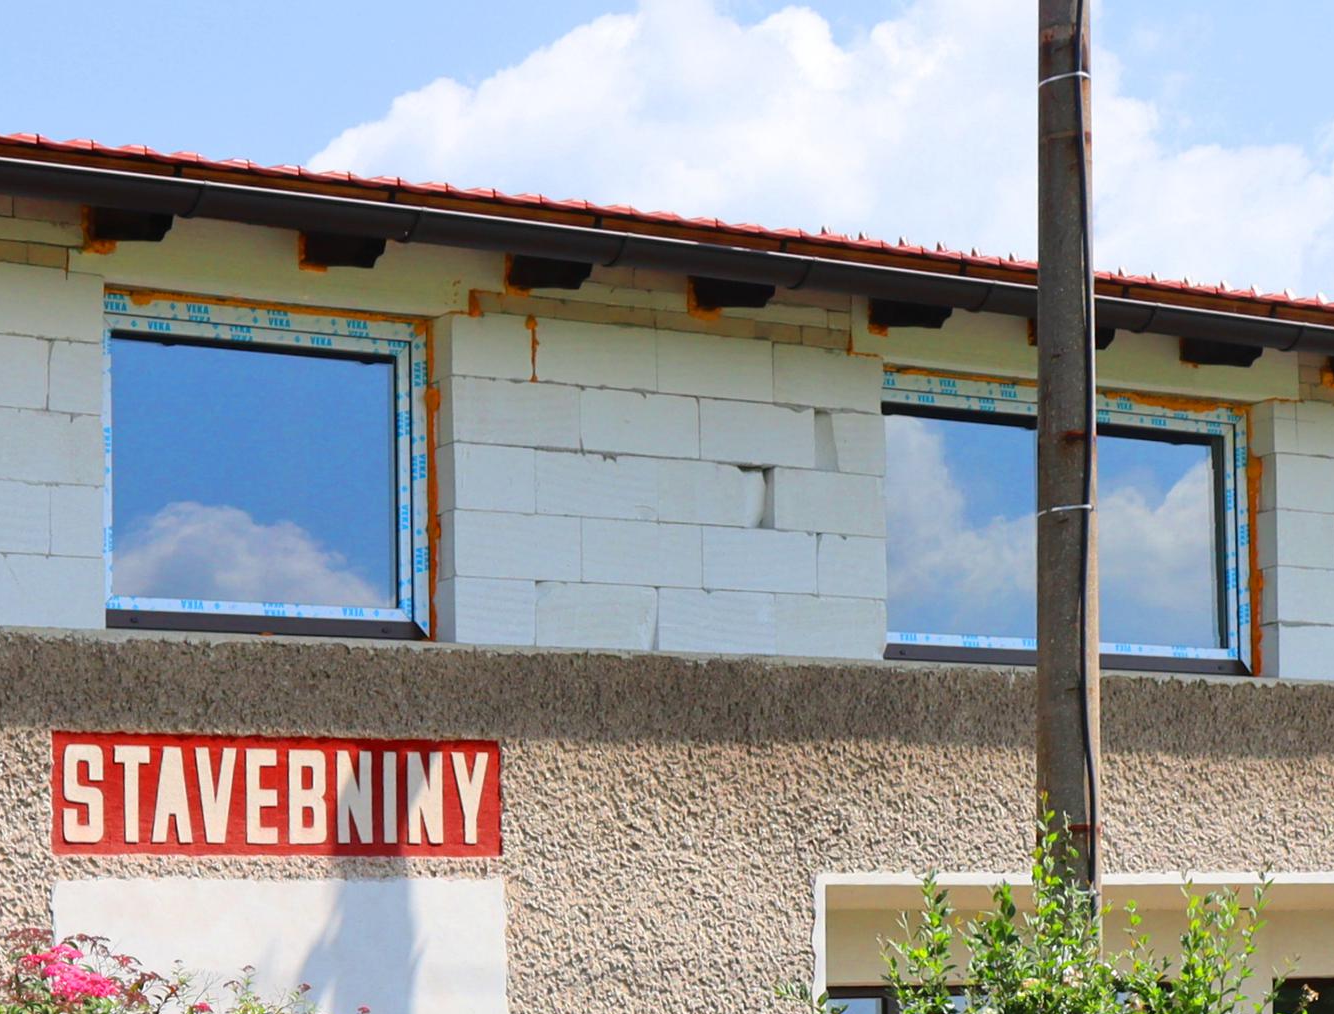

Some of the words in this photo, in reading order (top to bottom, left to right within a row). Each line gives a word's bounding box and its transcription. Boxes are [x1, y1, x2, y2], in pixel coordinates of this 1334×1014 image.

[104, 301, 127, 312] VEKA
[186, 303, 209, 314] VEKA
[148, 321, 171, 332] VEKA
[268, 317, 291, 328] VEKA
[346, 319, 368, 330] VEKA
[310, 335, 332, 346] VEKA
[414, 361, 423, 387] VEKA
[939, 379, 956, 388] VEKA
[918, 394, 935, 403] VEKA
[1001, 390, 1017, 398] VEKA
[419, 454, 427, 479] VEKA
[181, 599, 204, 610] VEKA
[342, 607, 364, 618] VEKA
[63, 743, 489, 846] STAVEBNINY
